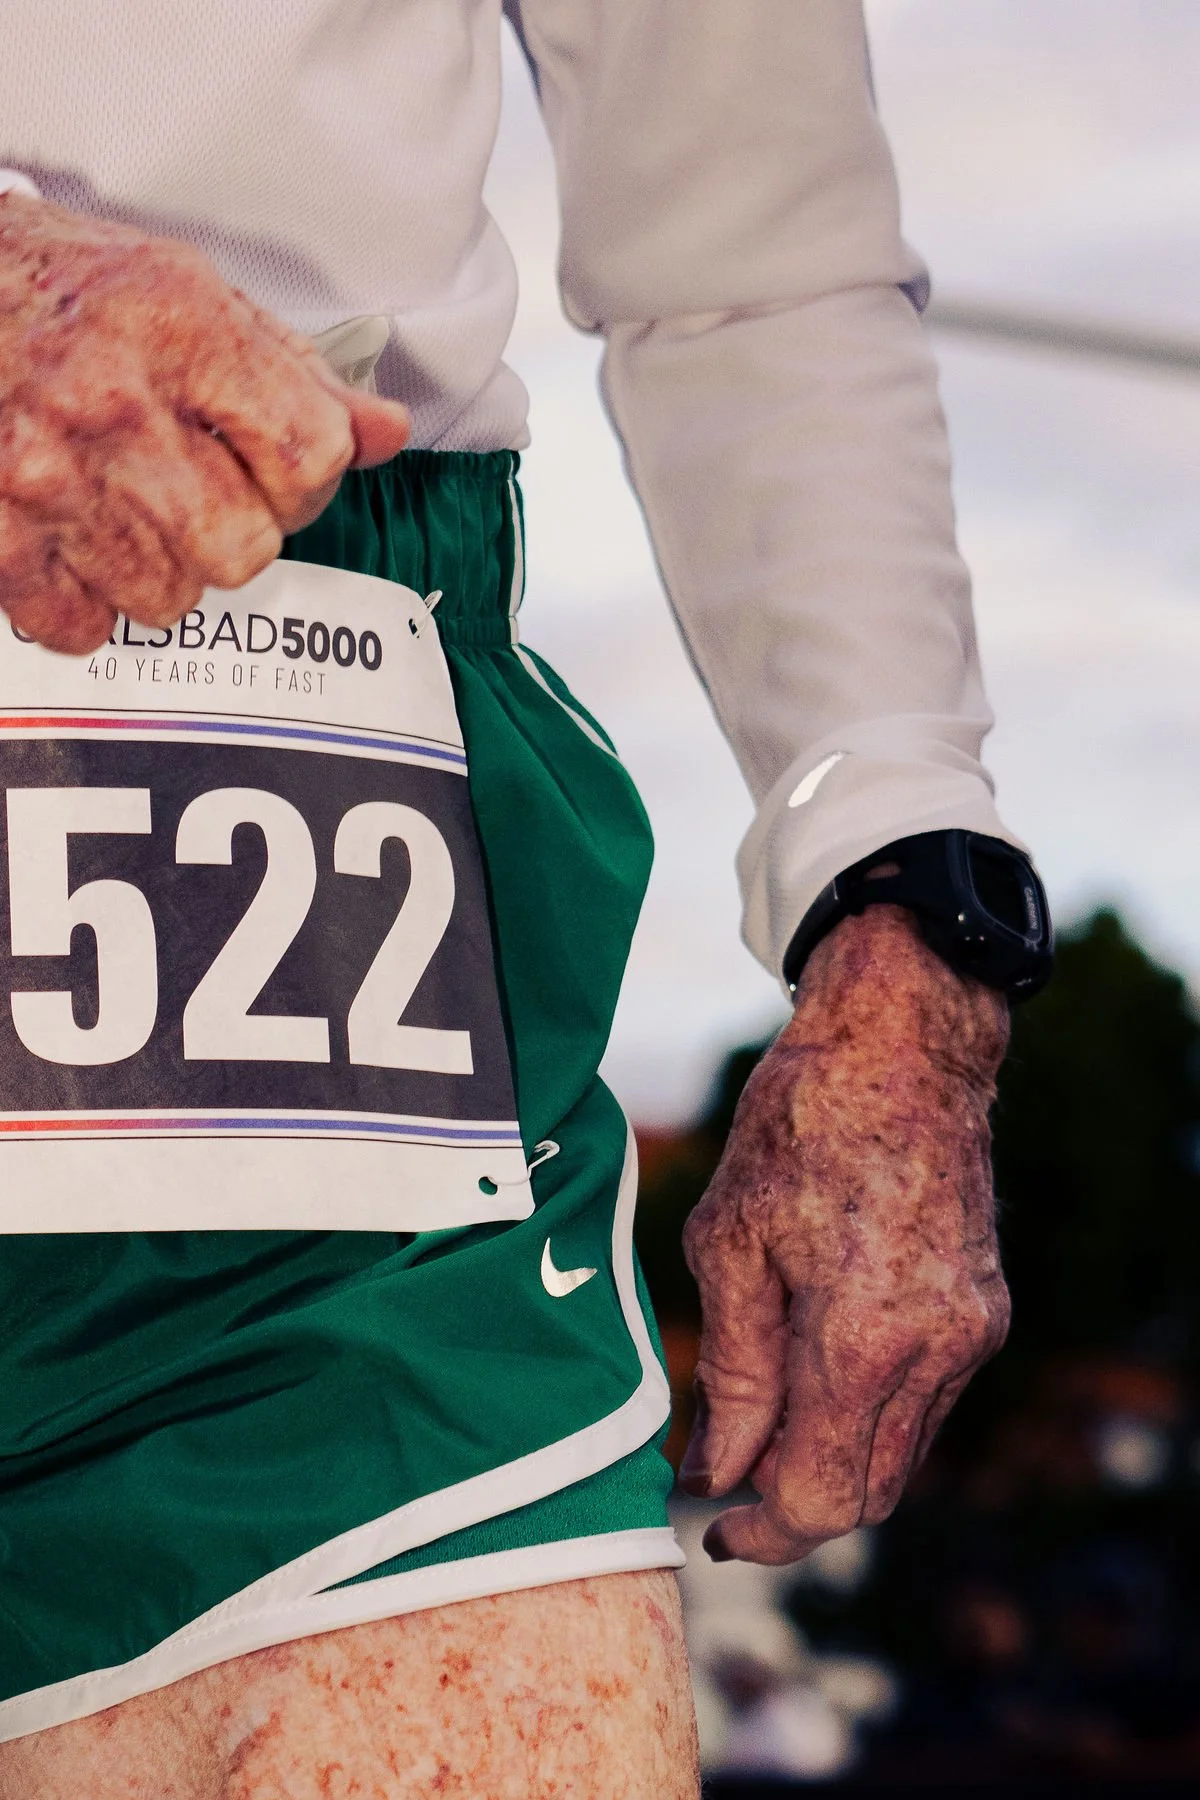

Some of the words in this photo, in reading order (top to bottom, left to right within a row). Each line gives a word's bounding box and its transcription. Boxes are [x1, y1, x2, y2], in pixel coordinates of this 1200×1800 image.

[11, 606, 383, 671] LSBAD5000
[87, 655, 119, 681] 40
[135, 657, 216, 686] YEARS
[232, 662, 260, 688] OF
[275, 666, 328, 696] FAST
